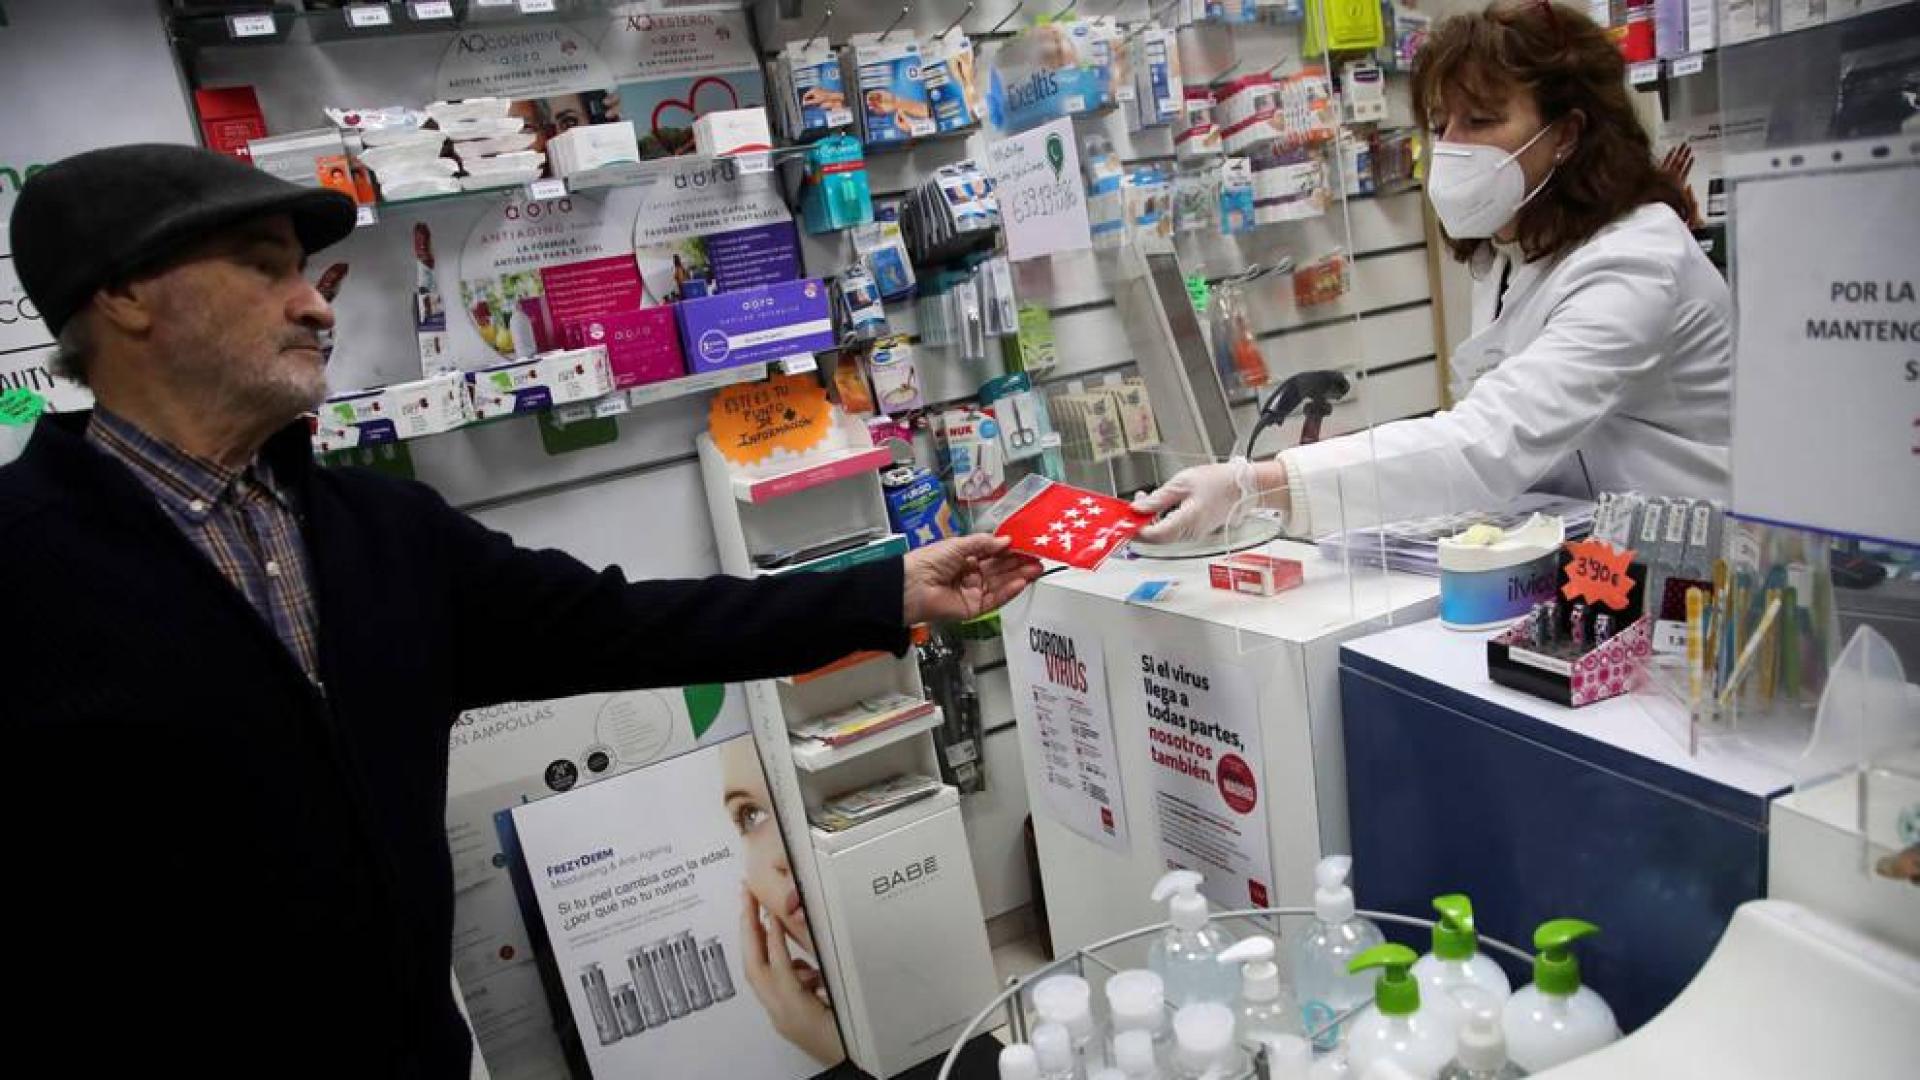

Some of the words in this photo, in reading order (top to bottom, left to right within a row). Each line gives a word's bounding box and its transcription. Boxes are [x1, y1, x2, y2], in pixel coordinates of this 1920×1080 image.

[1007, 70, 1058, 111] Exeltis
[504, 198, 573, 220] aora
[1831, 280, 1878, 304] POR
[1886, 280, 1915, 304] LA
[950, 425, 974, 437] NUK
[1029, 626, 1076, 659] CORONA
[1044, 651, 1088, 695] VIRUS
[1141, 654, 1155, 676] Si
[1157, 660, 1170, 680] el
[1171, 664, 1209, 692] virus
[1143, 677, 1178, 705] llega
[1179, 692, 1190, 708] a
[473, 704, 554, 743] AMPOLLAS
[1147, 700, 1186, 728] todas
[1190, 717, 1244, 753] partes,
[1149, 726, 1213, 761] nosotros
[1151, 744, 1215, 785] también.
[546, 847, 614, 878] FREZYDERM
[558, 899, 572, 915] Si
[573, 896, 587, 911] tu
[590, 886, 612, 908] piel
[615, 872, 661, 895] cambia
[663, 864, 686, 880] con
[687, 859, 699, 875] la
[563, 911, 592, 932] ¿por
[622, 893, 638, 907] no
[640, 886, 654, 902] tu
[656, 871, 697, 899] rutina?
